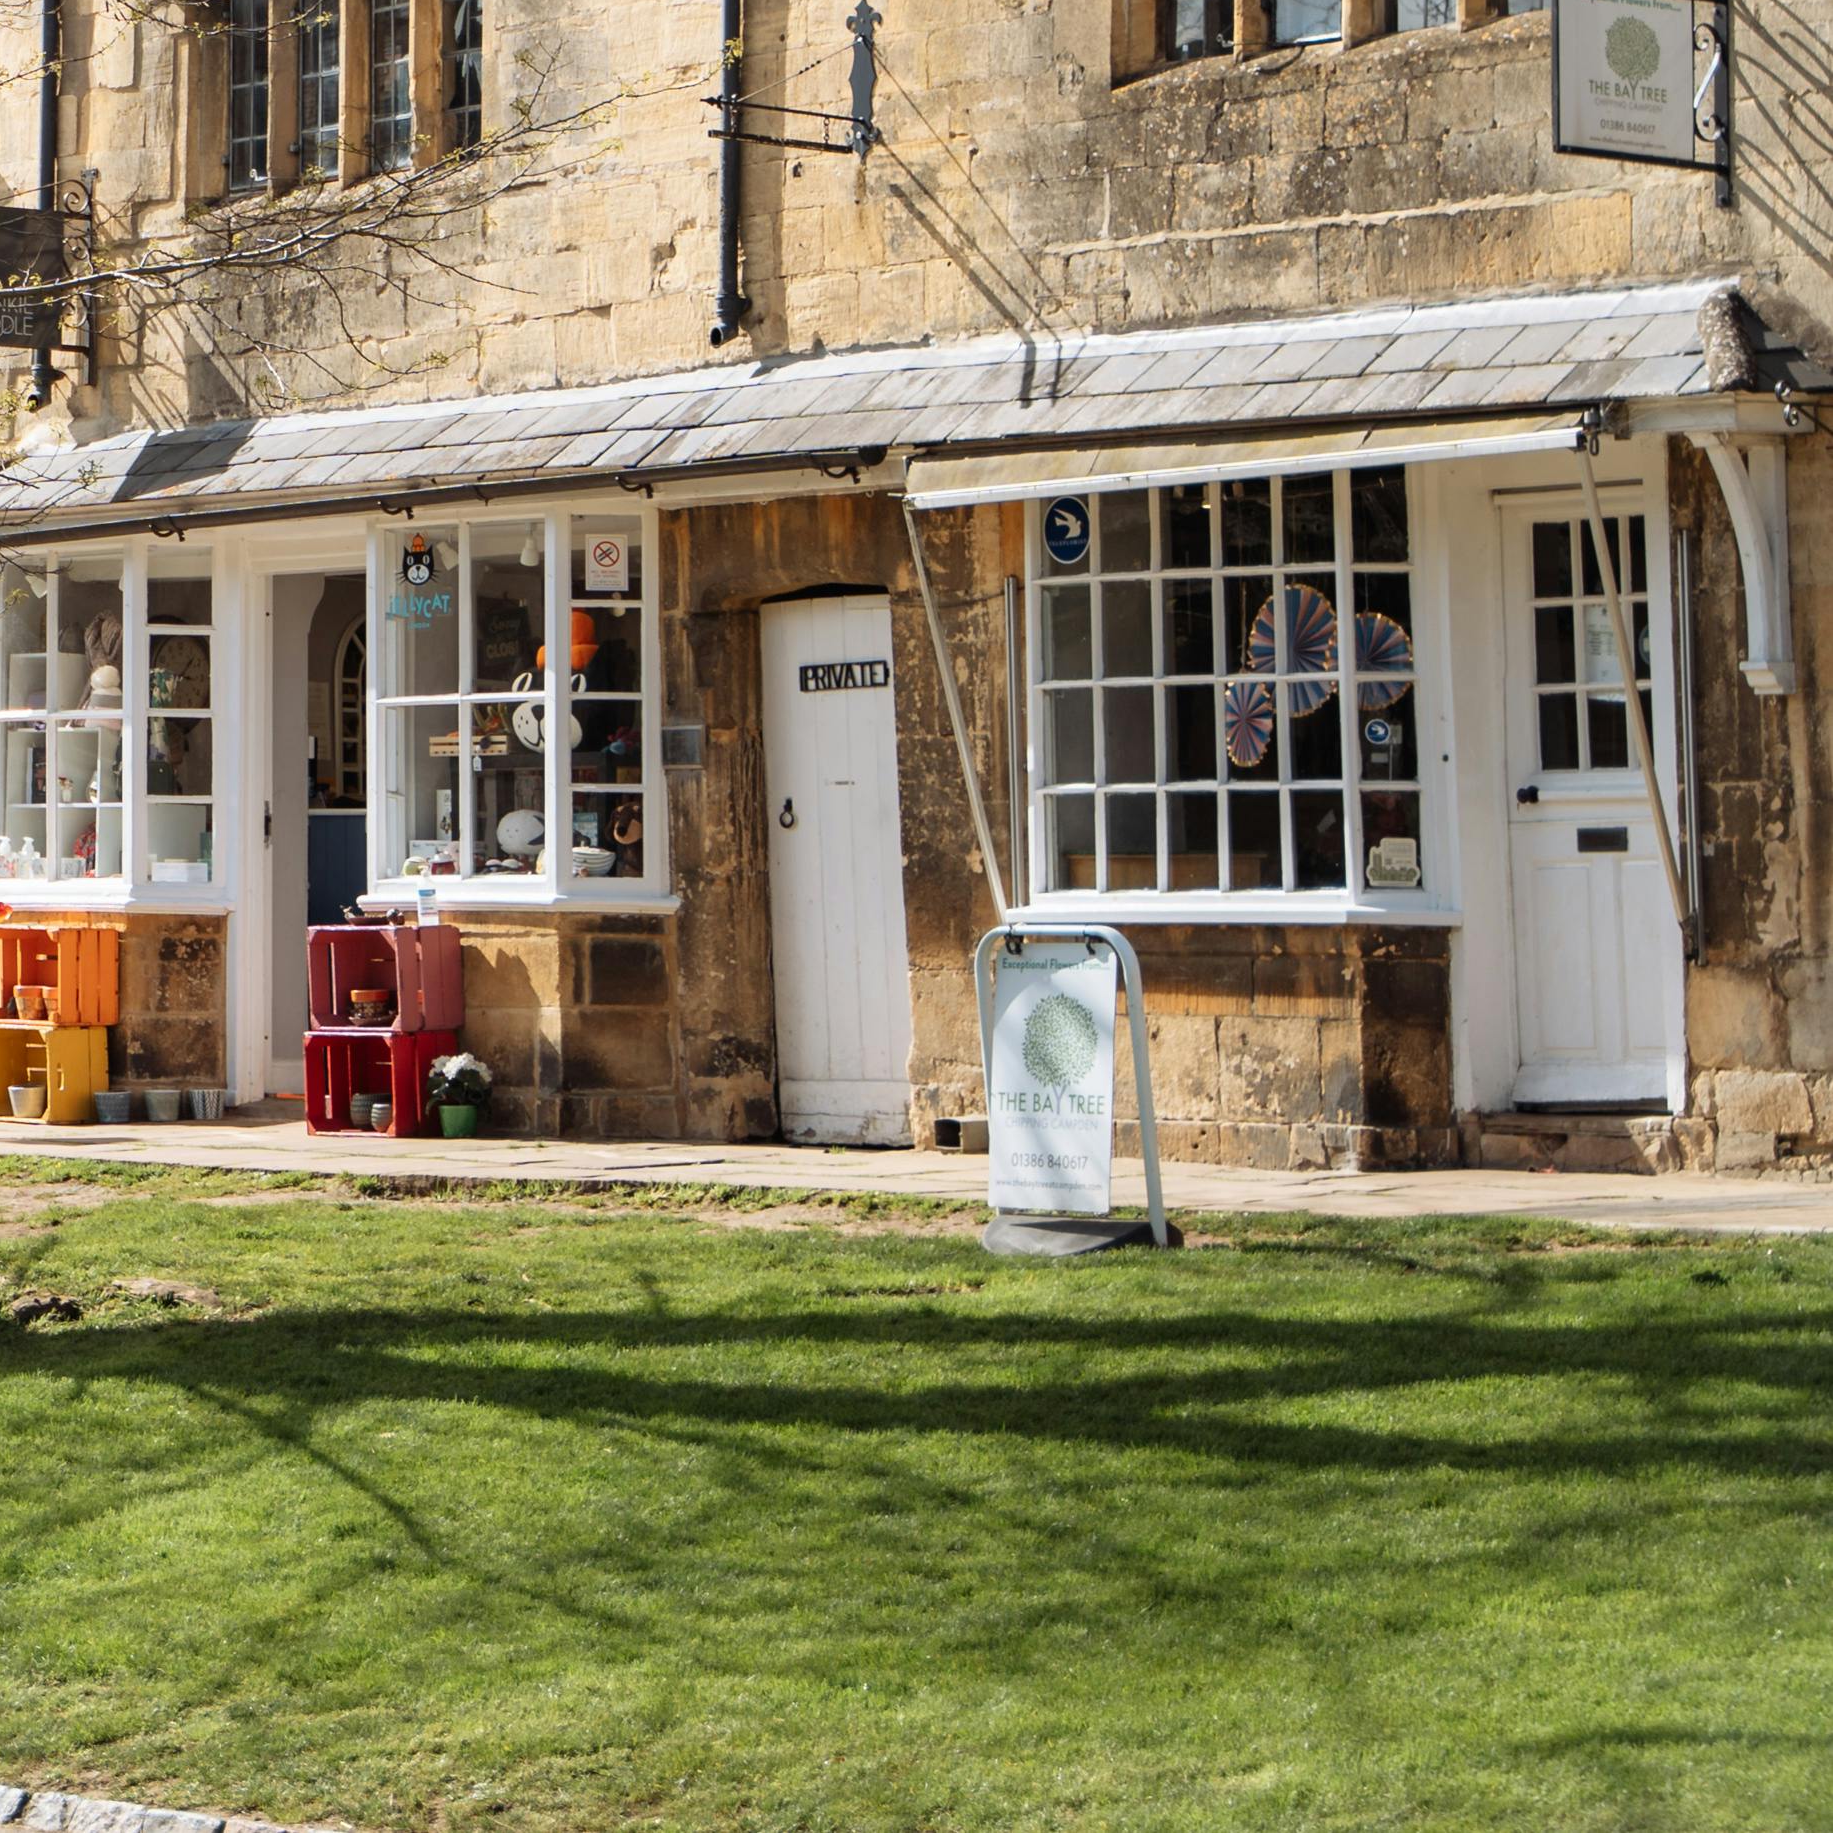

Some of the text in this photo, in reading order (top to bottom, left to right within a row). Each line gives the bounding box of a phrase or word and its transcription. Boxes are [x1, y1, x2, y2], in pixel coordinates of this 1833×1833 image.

[1589, 78, 1668, 104] THE BAY TREE
[1600, 119, 1625, 132] 01386
[804, 662, 885, 692] PRIVATE
[1002, 958, 1048, 973] Exceptional
[998, 1086, 1105, 1115] THE BAY TREE
[1005, 1116, 1099, 1131] CHIPPING CAMPDEN
[1011, 1153, 1088, 1170] 01386 840617
